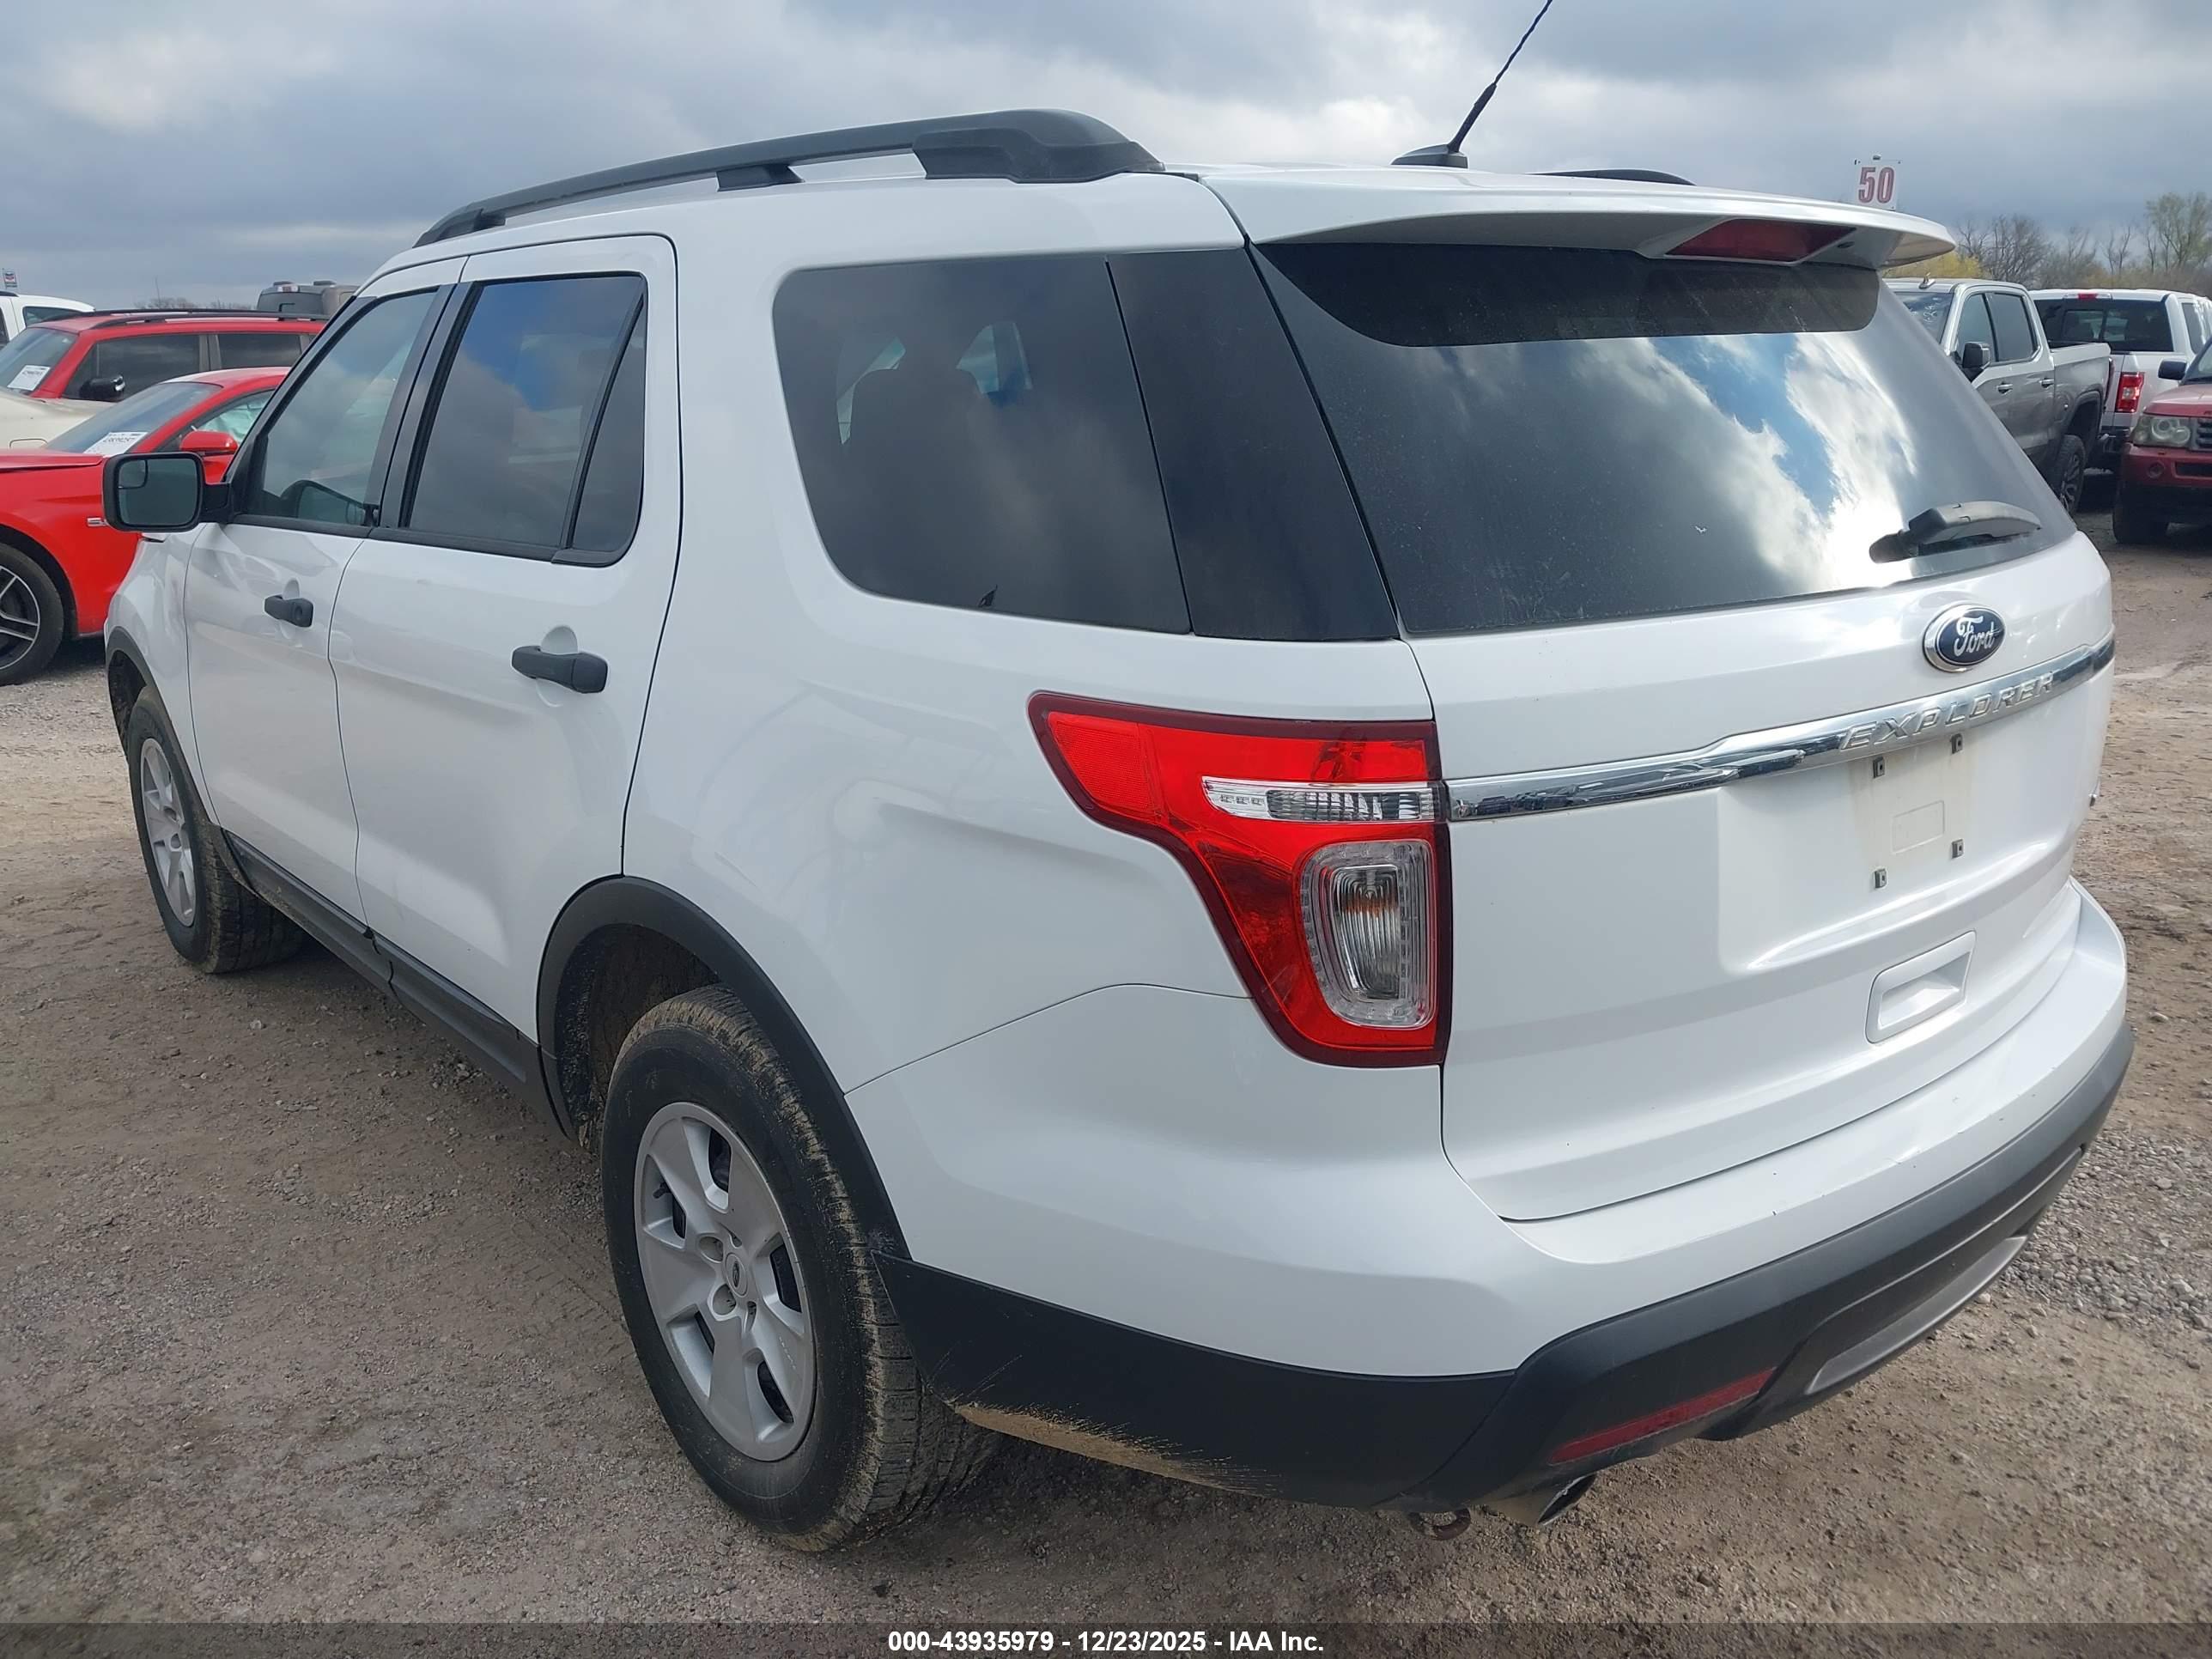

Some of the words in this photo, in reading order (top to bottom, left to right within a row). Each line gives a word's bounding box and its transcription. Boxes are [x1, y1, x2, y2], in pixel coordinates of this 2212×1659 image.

[1858, 167, 1895, 204] 50
[1954, 616, 2001, 656] Ford
[1839, 671, 2054, 750] EXPLORER
